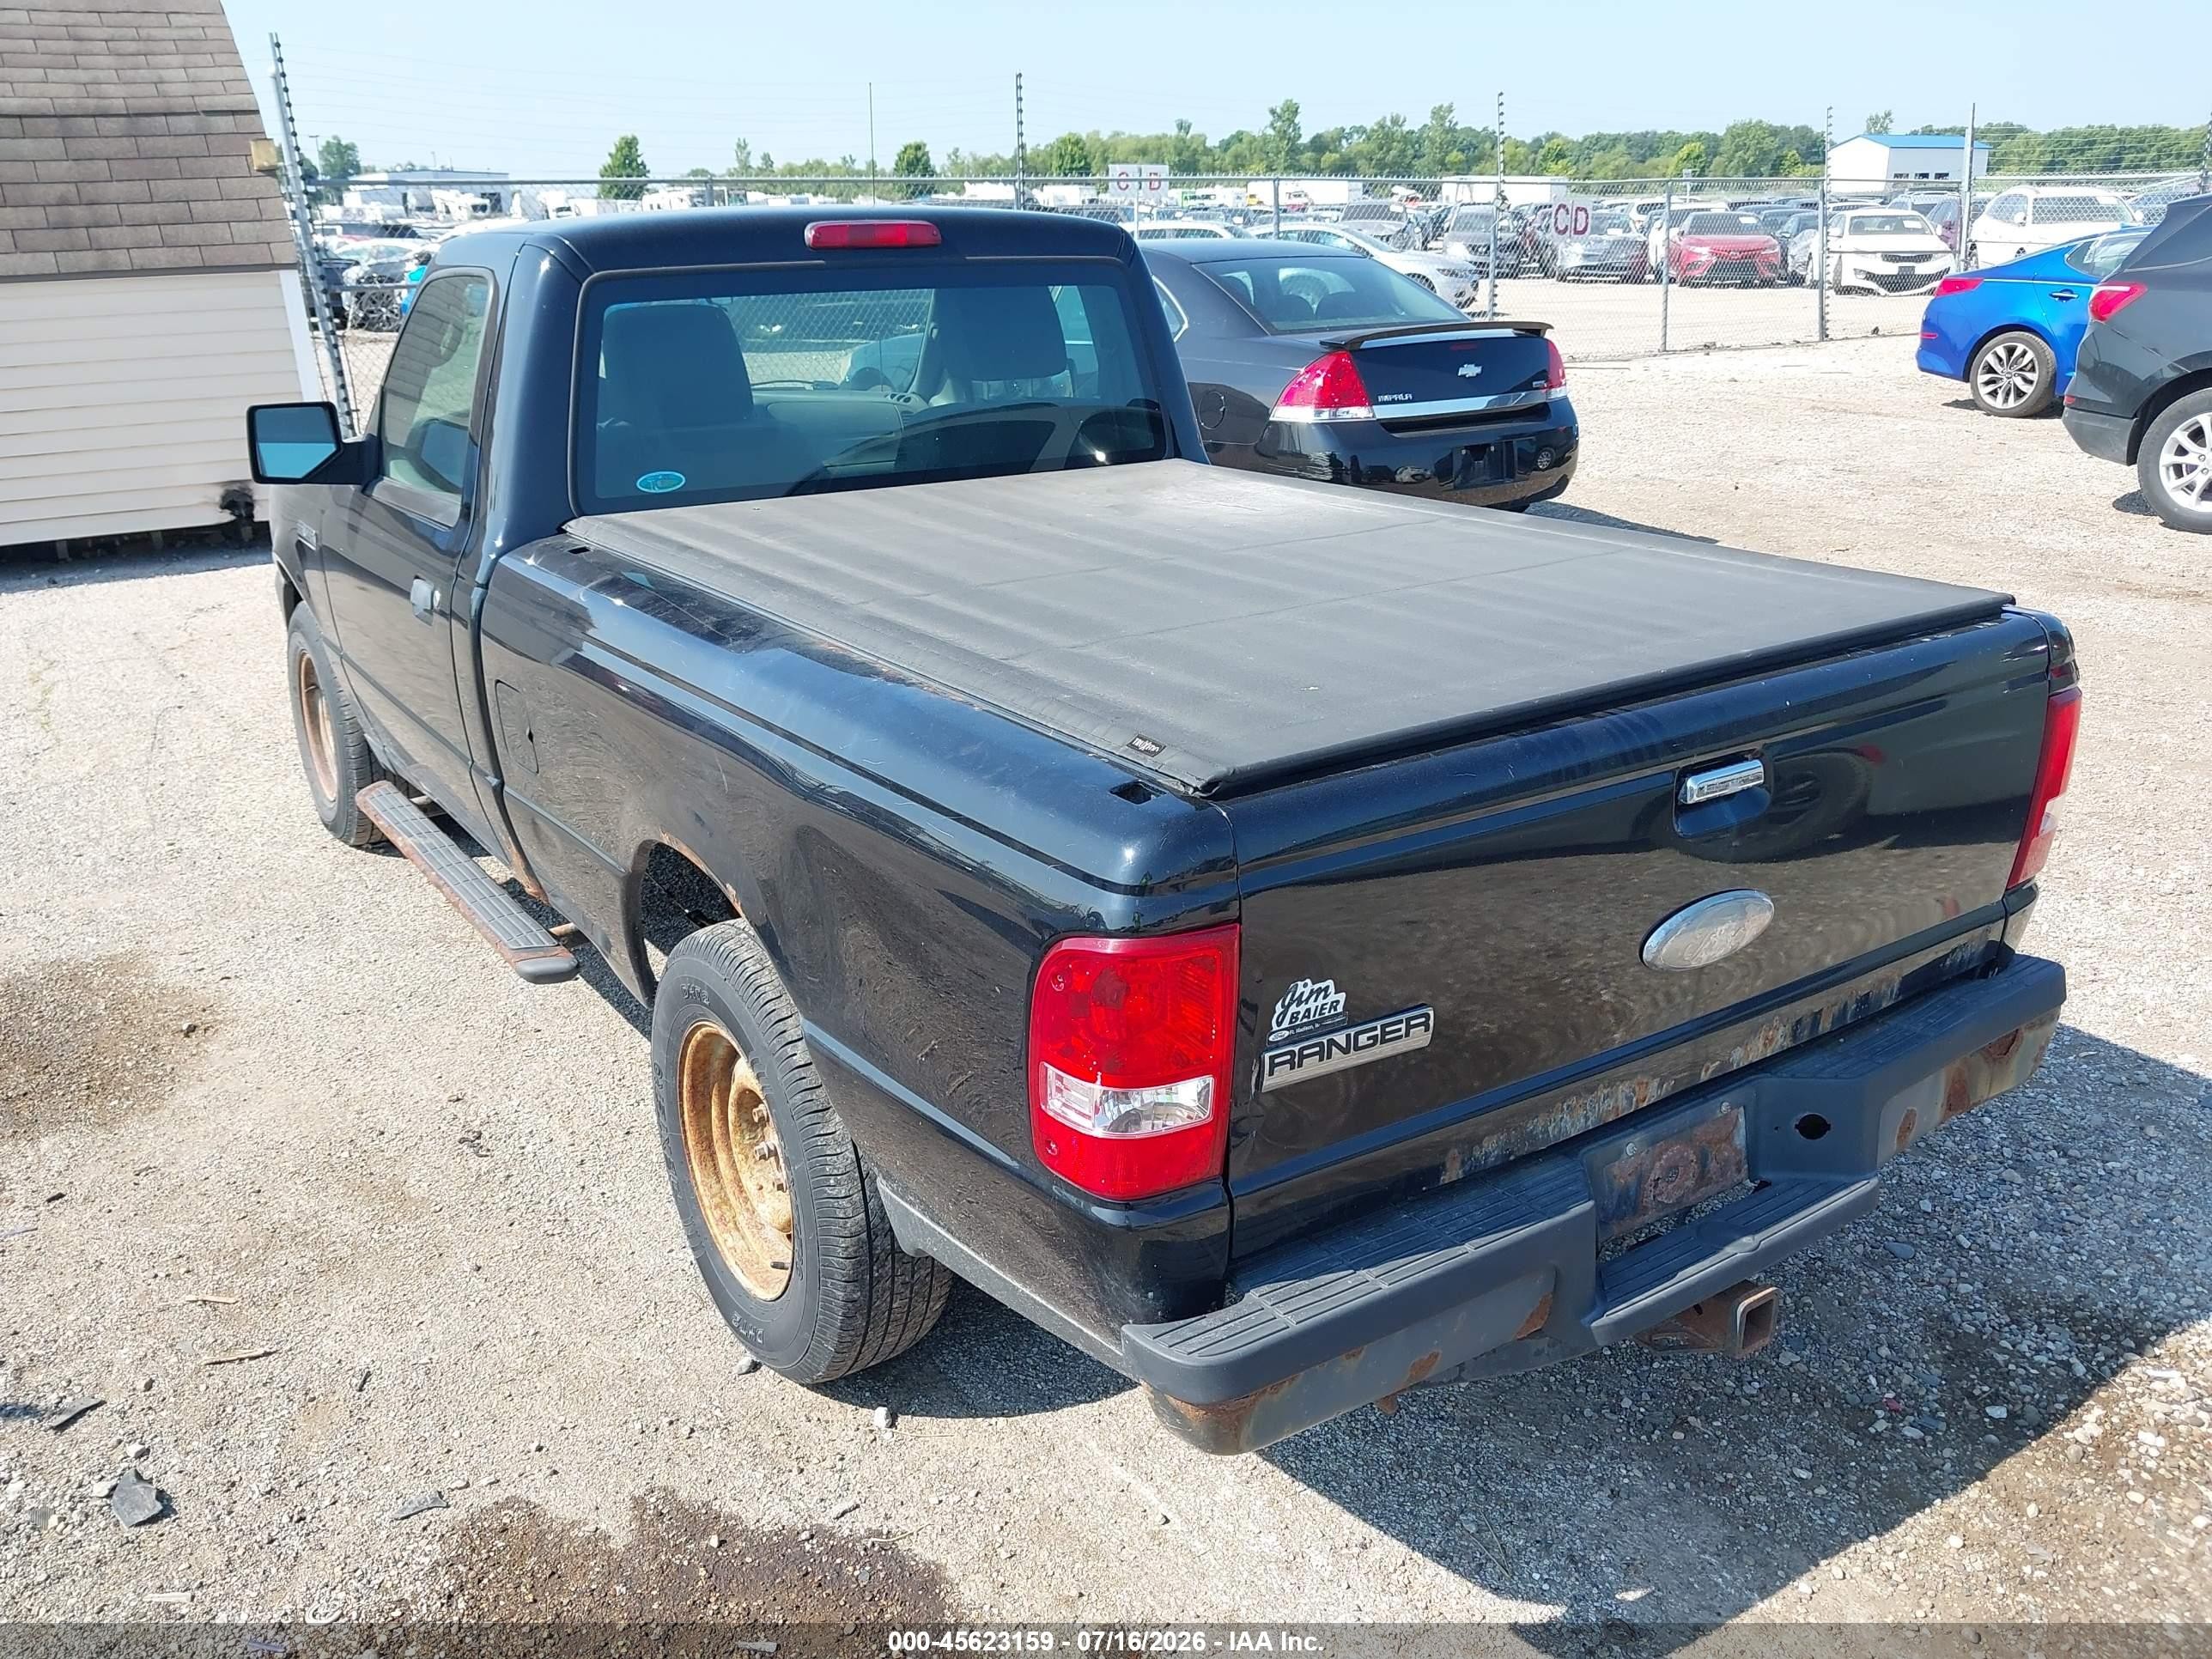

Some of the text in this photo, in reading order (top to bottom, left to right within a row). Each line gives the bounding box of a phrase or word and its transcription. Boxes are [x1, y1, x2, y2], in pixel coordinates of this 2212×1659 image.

[1116, 171, 1129, 191] C
[1377, 393, 1413, 402] IMPALA
[1275, 981, 1333, 1028] Jim
[1288, 1000, 1340, 1025] BAIER
[1267, 1011, 1432, 1078] RANGER
[731, 1310, 765, 1345] DHT2
